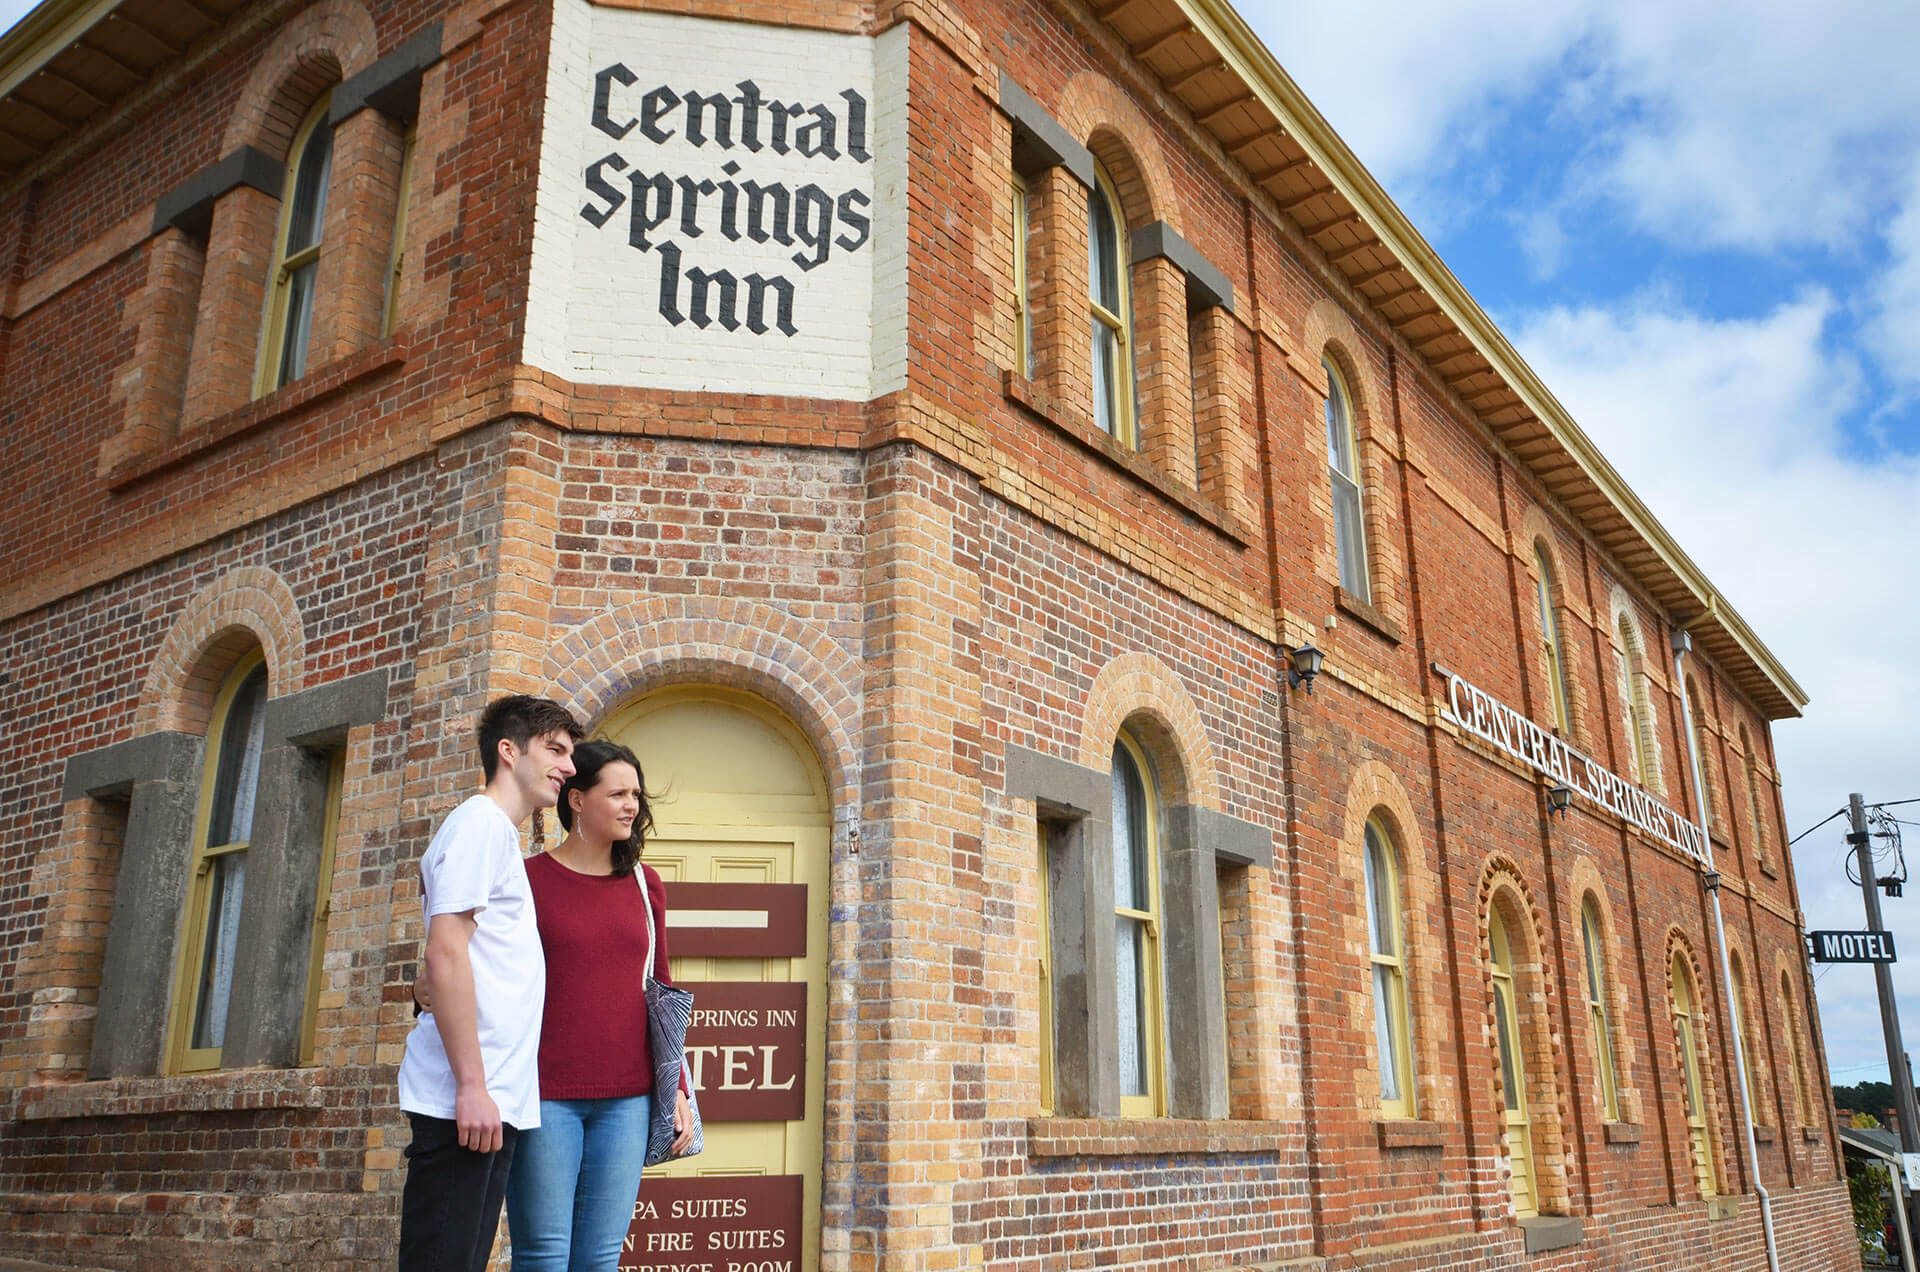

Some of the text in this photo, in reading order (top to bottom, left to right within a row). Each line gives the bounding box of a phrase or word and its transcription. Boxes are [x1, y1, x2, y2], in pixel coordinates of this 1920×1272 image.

[591, 62, 872, 164] Central
[580, 152, 871, 272] Springs
[655, 240, 799, 338] Inn
[1449, 673, 1705, 862] CENTRAL SPRINGS INN
[1822, 934, 1892, 959] MOTEL
[766, 1009, 797, 1027] INN
[684, 1045, 796, 1091] TEL
[631, 1198, 747, 1220] PA SUITES
[646, 1232, 694, 1252] FIRE
[708, 1229, 785, 1250] SUITES
